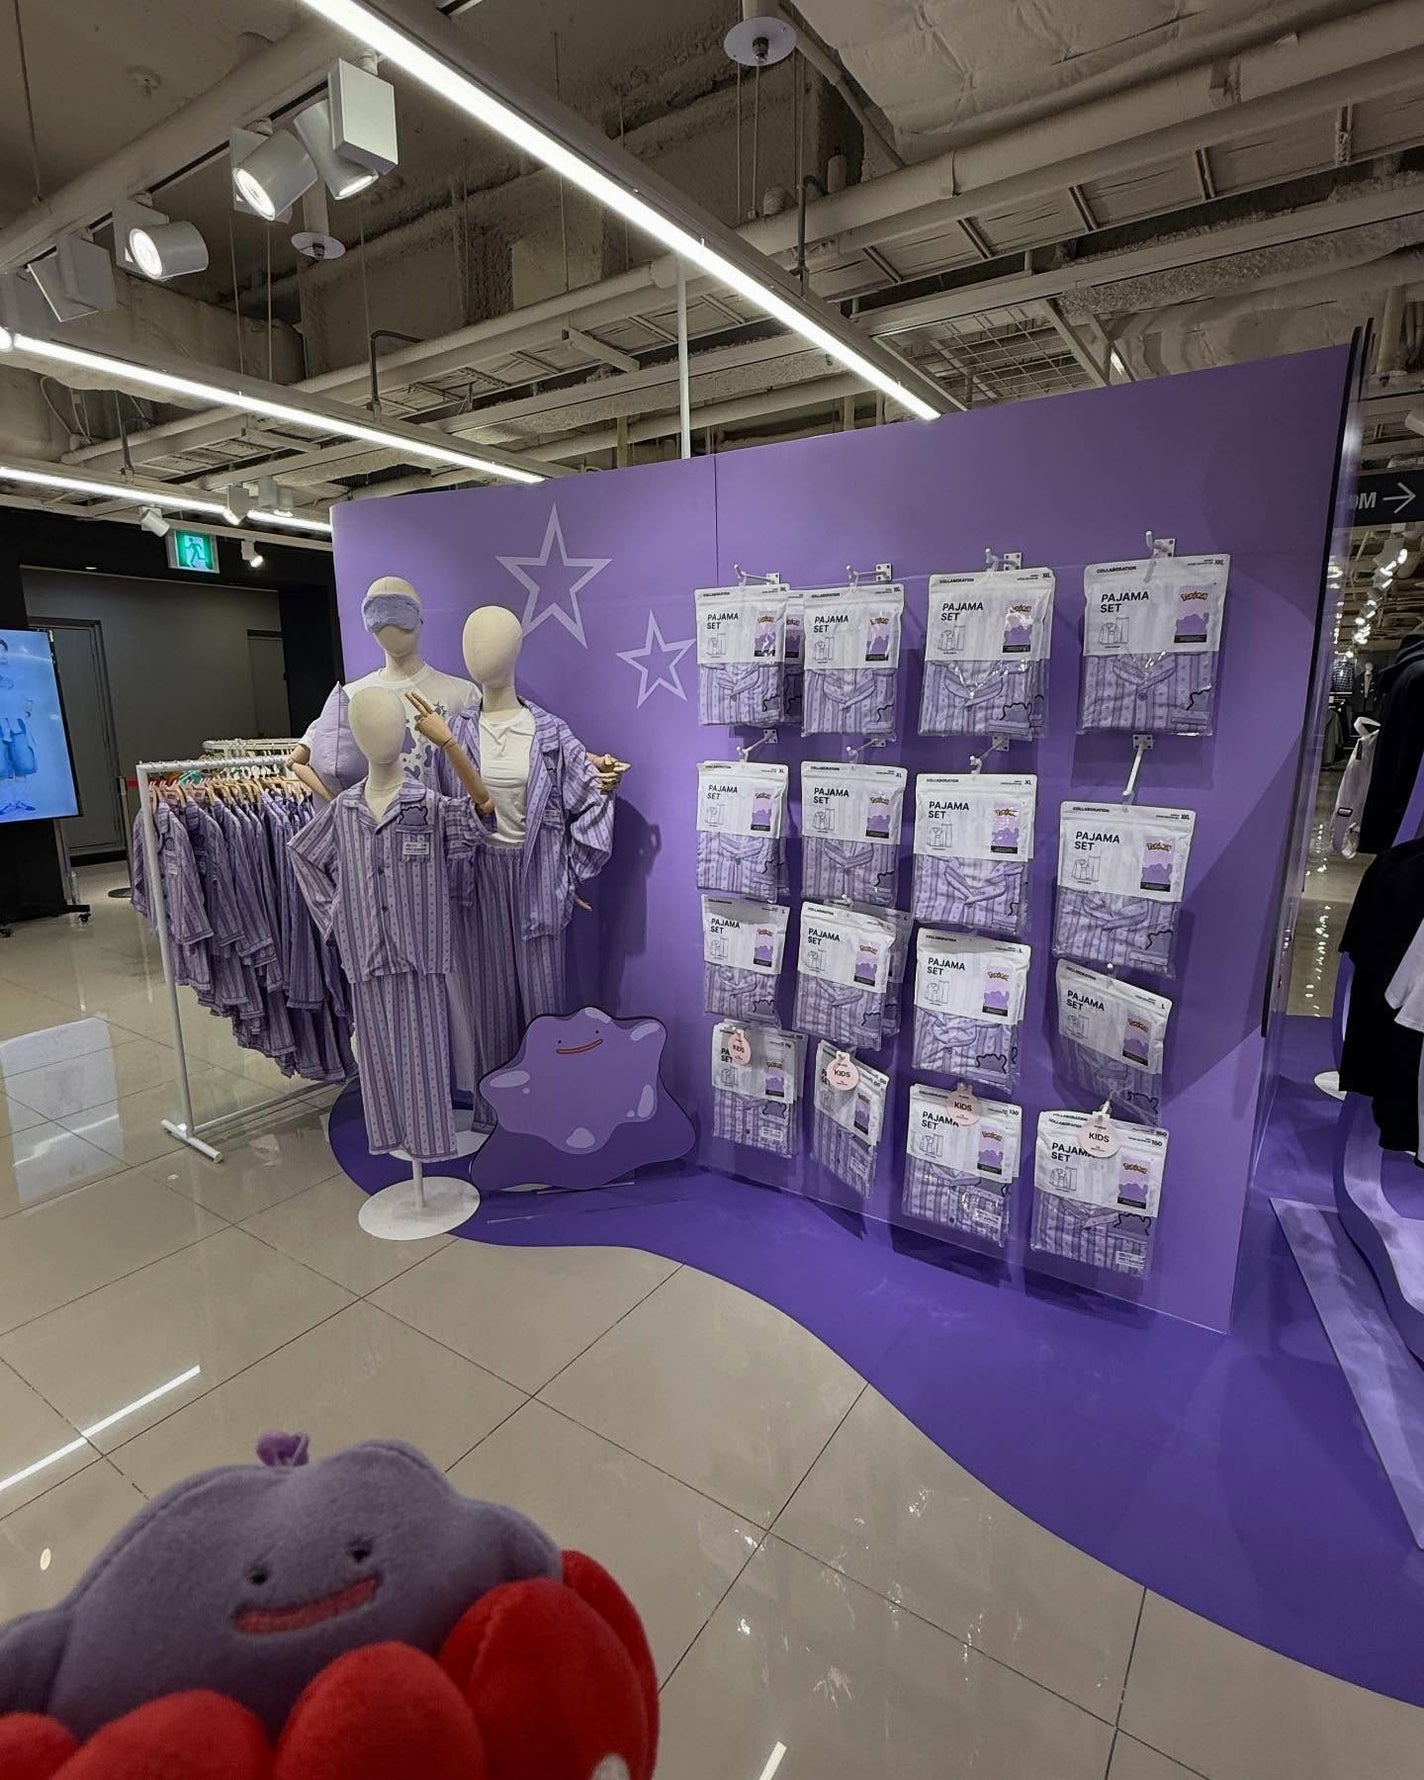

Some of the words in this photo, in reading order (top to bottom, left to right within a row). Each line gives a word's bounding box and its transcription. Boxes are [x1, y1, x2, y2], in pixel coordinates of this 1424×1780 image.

[1096, 565, 1137, 574] COLLABORATION
[1101, 591, 1150, 603] PAJAMA
[942, 602, 984, 612] PAJAMA
[1100, 603, 1122, 614] SET
[707, 612, 739, 620] PAJAMA
[814, 614, 849, 624] PAJAMA
[940, 612, 960, 622] SET
[706, 621, 721, 630] SET
[813, 624, 829, 633] SET
[708, 784, 739, 794] PAJAMA
[814, 787, 850, 798] PAJAMA
[706, 792, 721, 800] SET
[813, 796, 829, 805] SET
[928, 801, 970, 811] PAJAMA
[928, 810, 946, 819] SET
[1075, 830, 1121, 845] PAJAMA
[1074, 840, 1095, 851] SET
[711, 918, 741, 929] PAJAMA
[710, 925, 724, 935] SET
[808, 927, 841, 942] PAJAMA
[807, 936, 822, 946] SET
[927, 957, 966, 971] PAJAMA
[926, 966, 944, 976] SET
[1066, 998, 1083, 1011] SET
[1067, 990, 1105, 1011] PAJAMA
[732, 1044, 745, 1054] KIDS
[833, 1069, 851, 1079] KIDS
[953, 1101, 973, 1112] KIDS
[921, 1119, 939, 1130] SET
[1088, 1131, 1110, 1143] KIDS
[1051, 1151, 1071, 1163] SET
